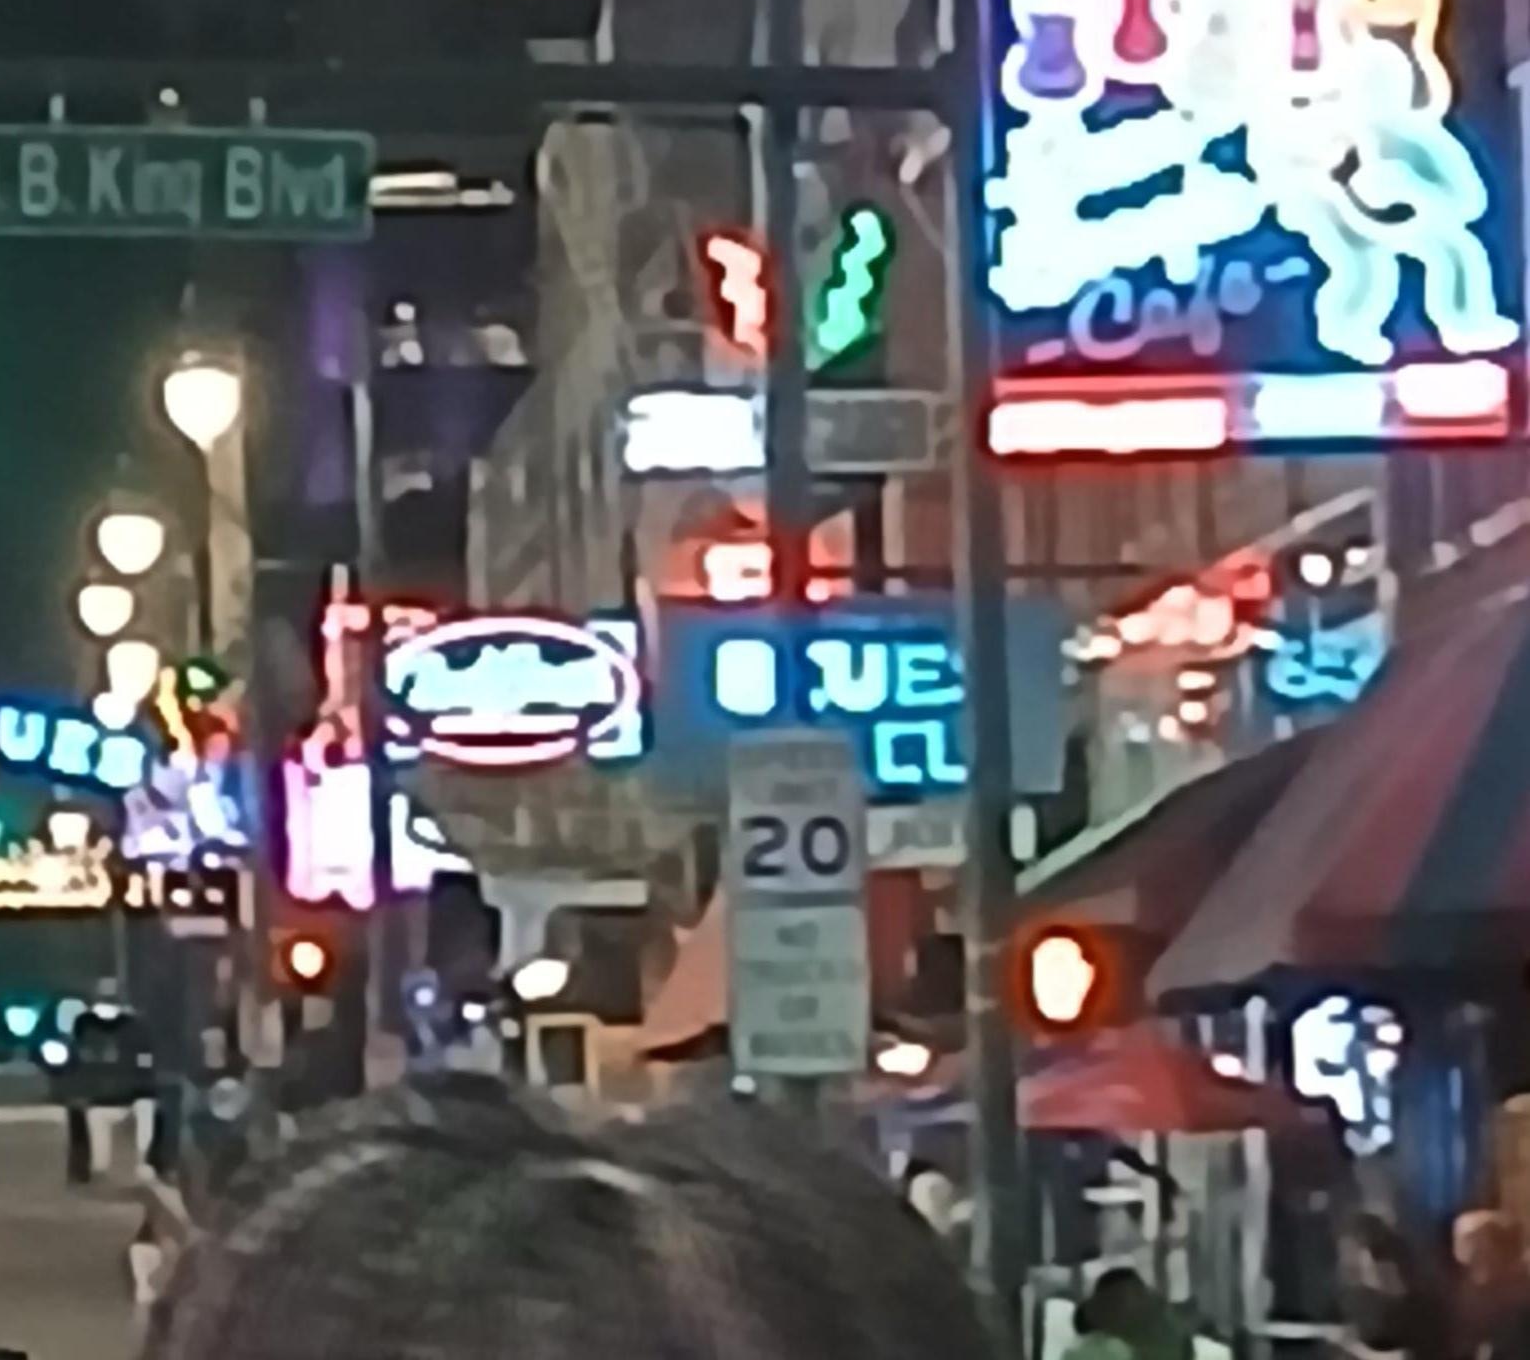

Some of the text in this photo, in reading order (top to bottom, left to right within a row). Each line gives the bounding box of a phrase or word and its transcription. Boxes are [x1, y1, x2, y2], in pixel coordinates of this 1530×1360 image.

[87, 145, 202, 228] King
[226, 145, 345, 220] Blvd
[740, 814, 850, 877] 20
